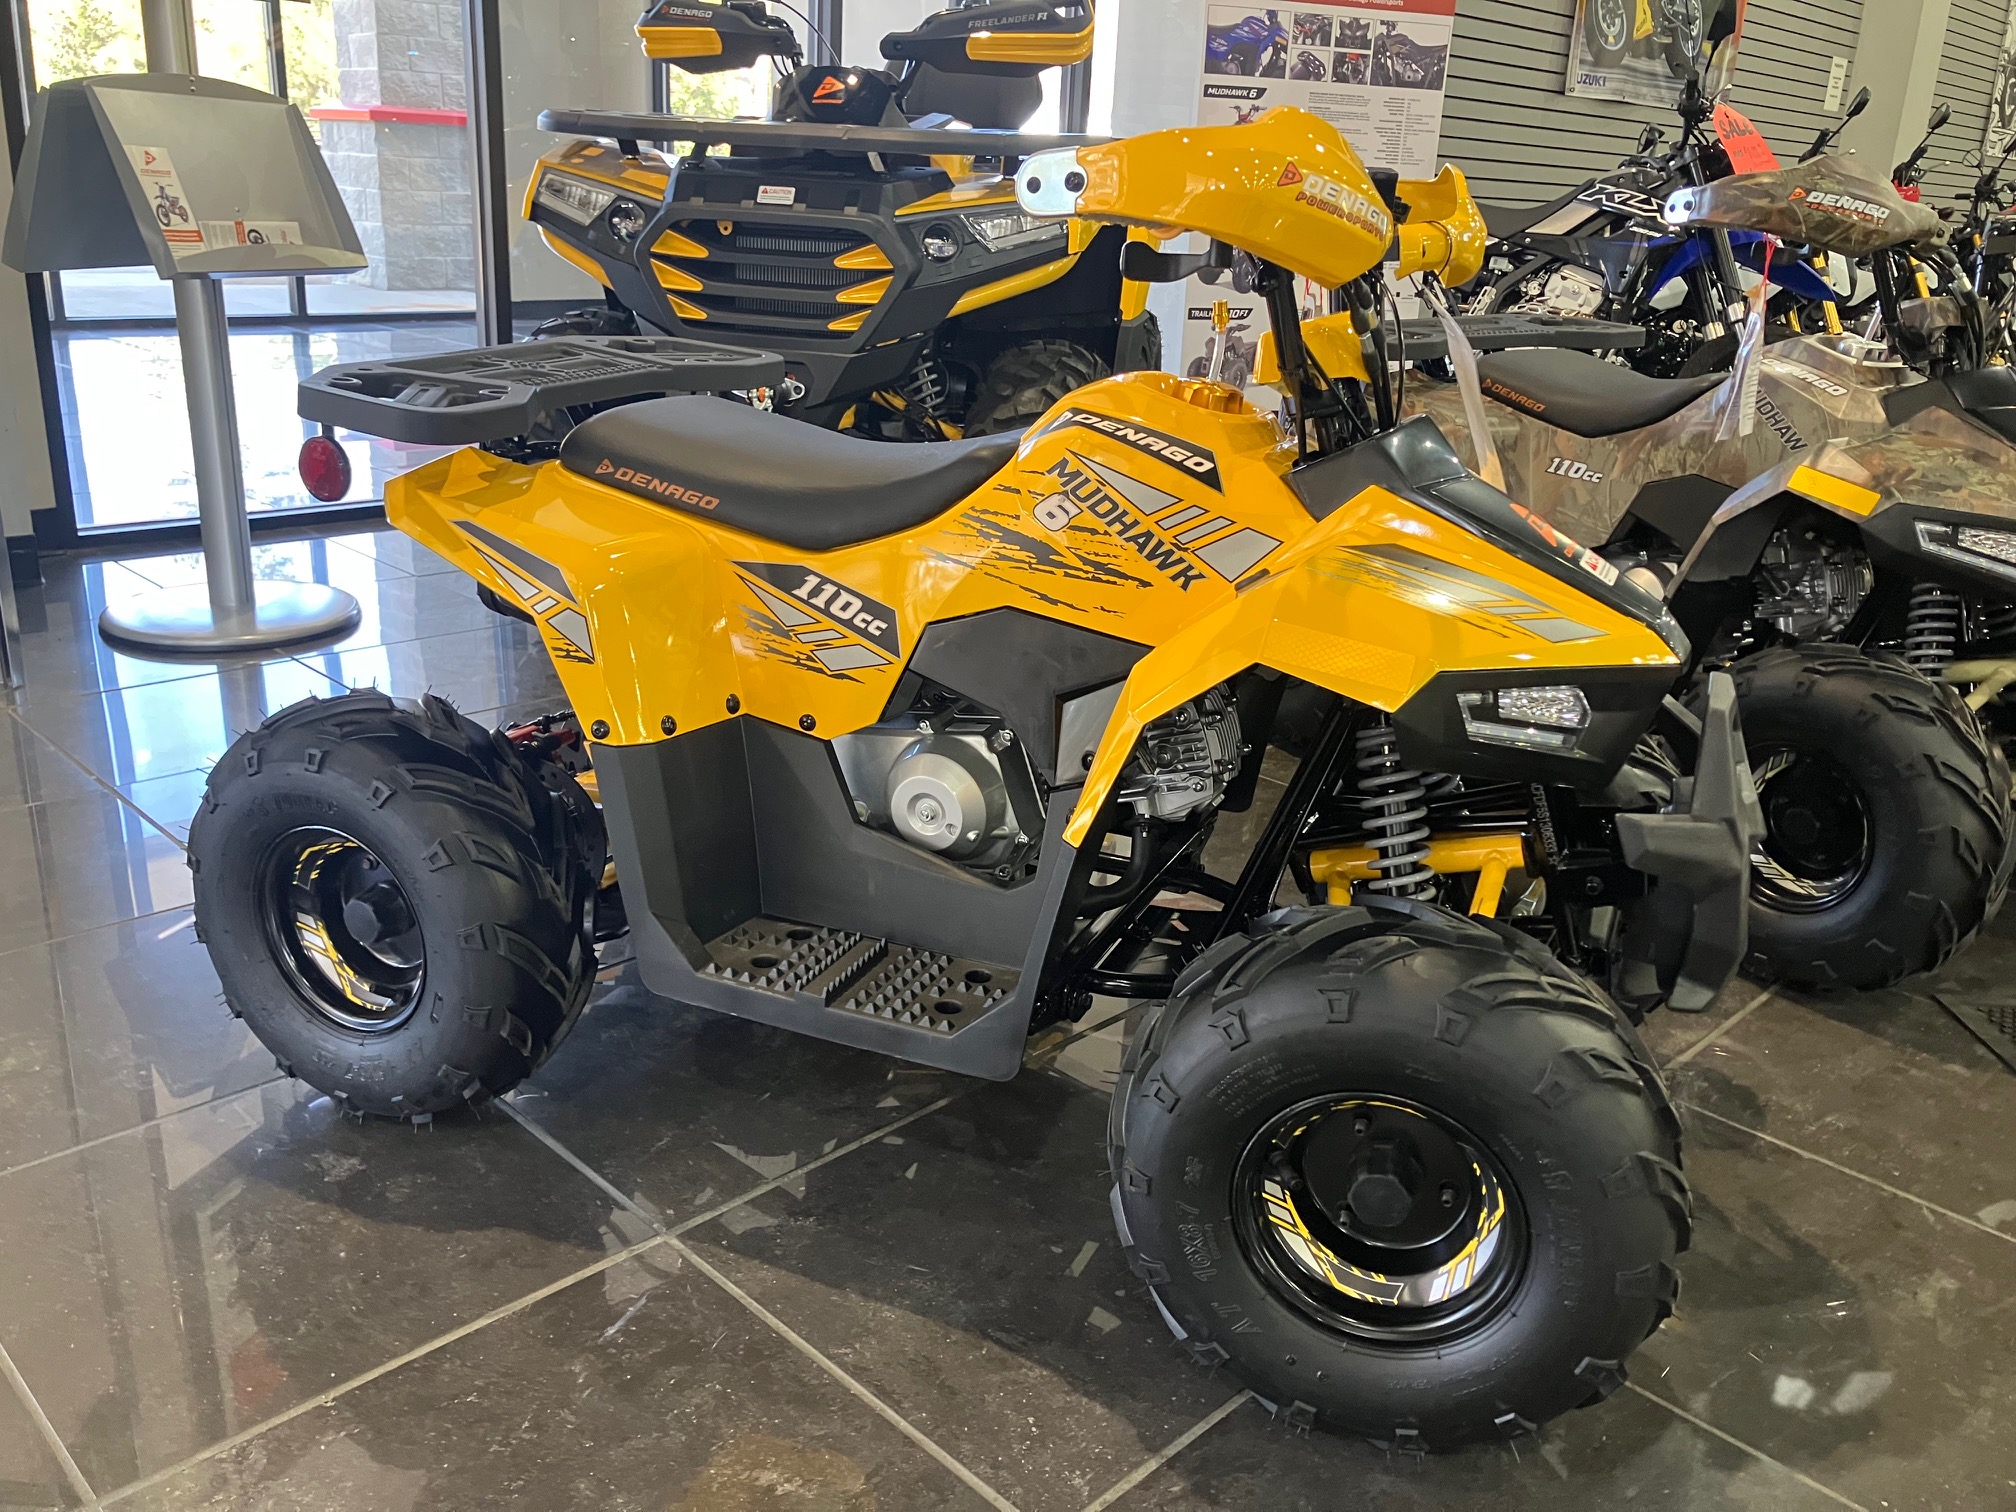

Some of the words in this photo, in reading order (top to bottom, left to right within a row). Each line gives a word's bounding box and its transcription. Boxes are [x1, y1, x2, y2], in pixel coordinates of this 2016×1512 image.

[669, 7, 713, 18] DENAGO
[968, 14, 1036, 28] FREELANDER
[1037, 12, 1048, 21] FI
[1207, 88, 1249, 97] MUDHAWK
[1249, 89, 1258, 98] 6
[1577, 73, 1607, 87] UZUKI
[1806, 191, 1891, 220] DENAGO
[1191, 310, 1212, 318] TRAIL
[1491, 383, 1546, 412] DENAGO
[1755, 389, 1809, 451] DHAW
[1073, 413, 1215, 473] DENAGO
[1546, 457, 1604, 483] 110cc
[614, 467, 720, 510] DENAGO
[1033, 491, 1083, 531] 6
[1045, 456, 1210, 593] MUDHAWK
[791, 573, 889, 637] 110cc
